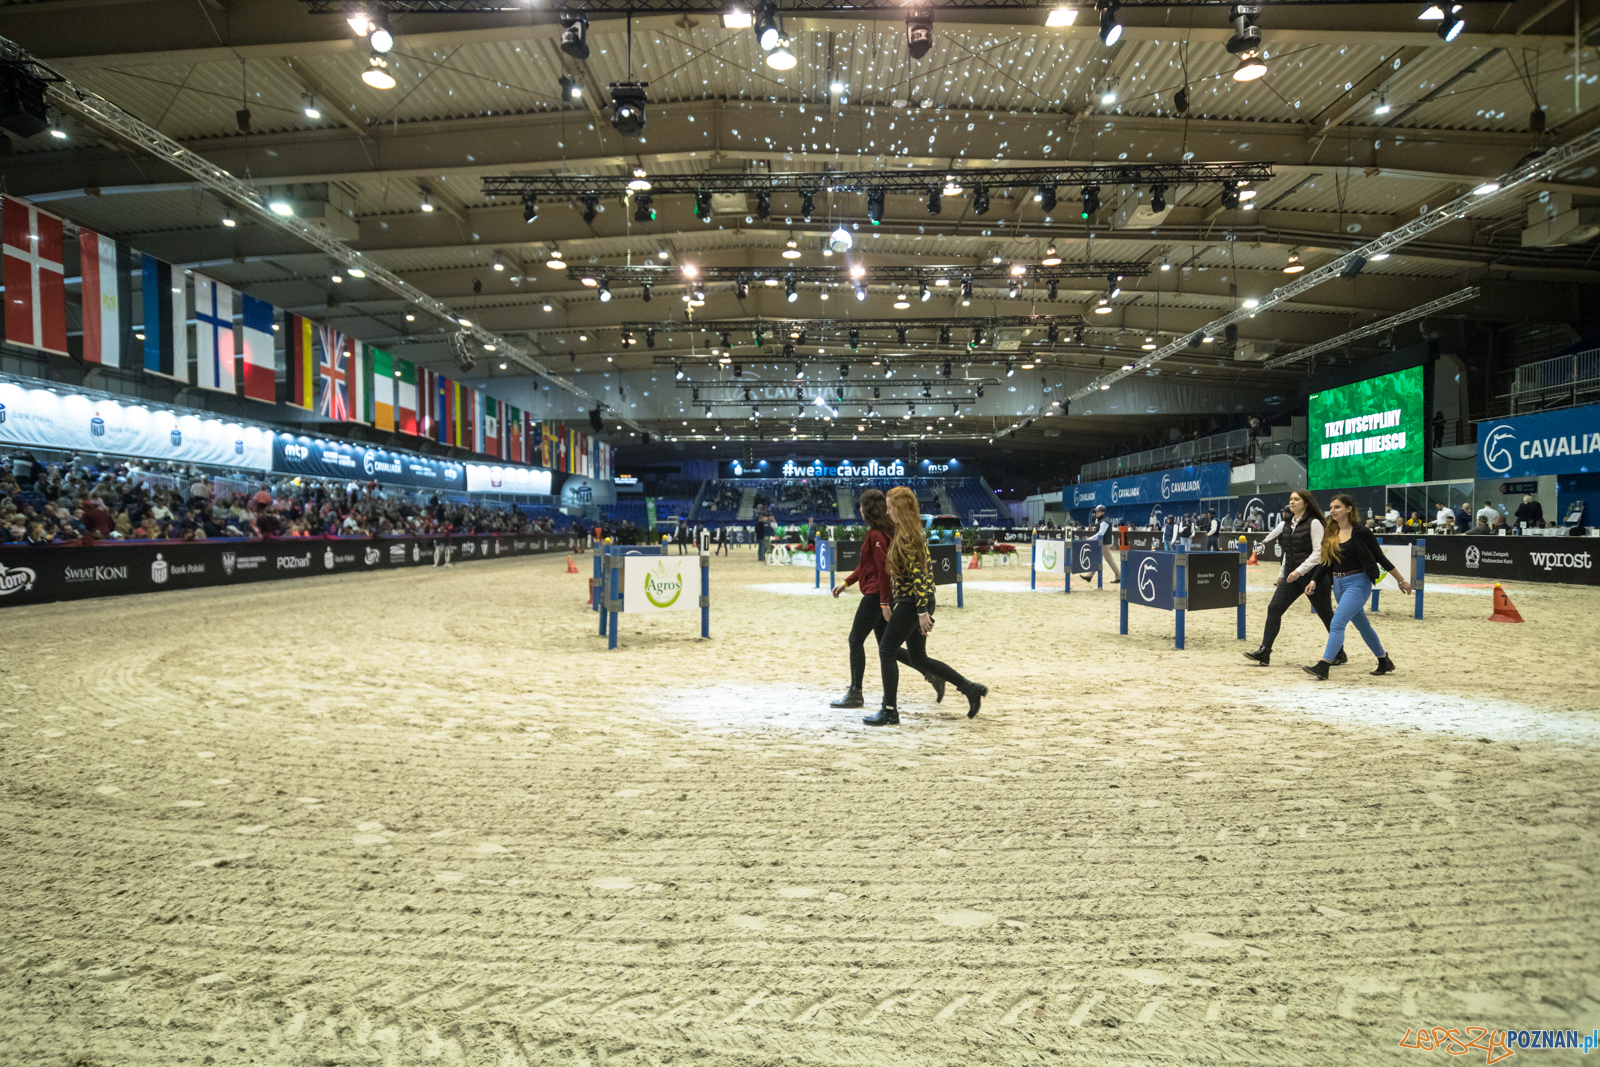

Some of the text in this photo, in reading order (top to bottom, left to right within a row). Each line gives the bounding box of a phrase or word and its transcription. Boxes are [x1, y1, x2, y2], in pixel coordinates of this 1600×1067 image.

[1325, 409, 1401, 438] TRZY DYSCYPLINY
[285, 443, 309, 459] mtp
[1321, 432, 1406, 459] W JEDNYM MIEJSCU
[928, 464, 949, 473] mtp
[1118, 487, 1141, 498] CAVALIADA
[1171, 480, 1201, 493] CAVALIADA
[1431, 554, 1447, 562] Polski
[1530, 551, 1592, 571] wprost
[95, 565, 127, 580] KONI
[170, 565, 187, 574] Bank
[187, 563, 205, 573] Polski
[0, 572, 27, 590] LOTTO
[647, 579, 681, 595] Agros
[1501, 594, 1507, 606] 7
